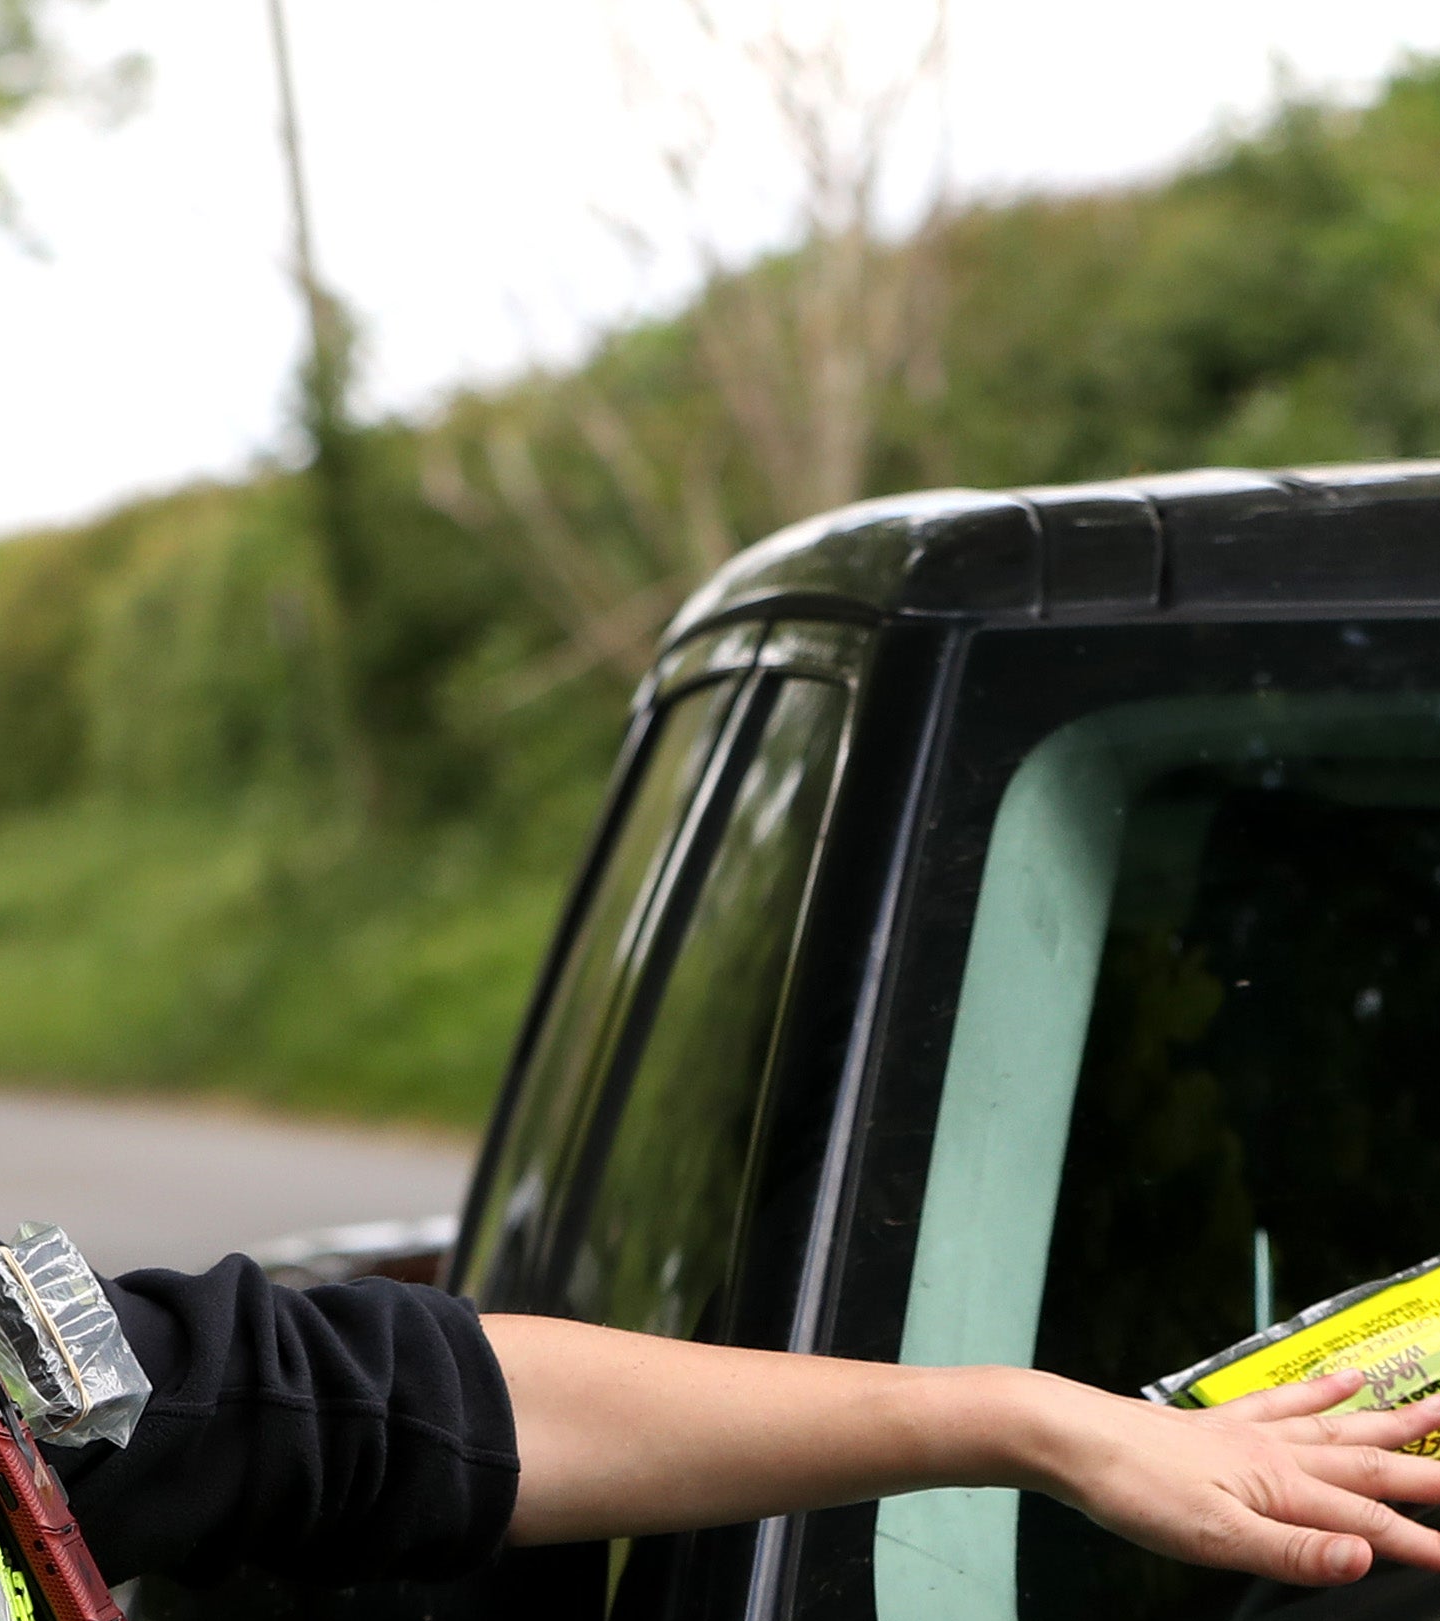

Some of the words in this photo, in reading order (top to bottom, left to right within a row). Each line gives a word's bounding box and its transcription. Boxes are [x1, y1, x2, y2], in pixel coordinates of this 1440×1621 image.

[1359, 1316, 1404, 1342] THAN
[1361, 1315, 1433, 1354] OFFENCE
[1326, 1336, 1360, 1359] THE
[1362, 1345, 1427, 1382] WARN
